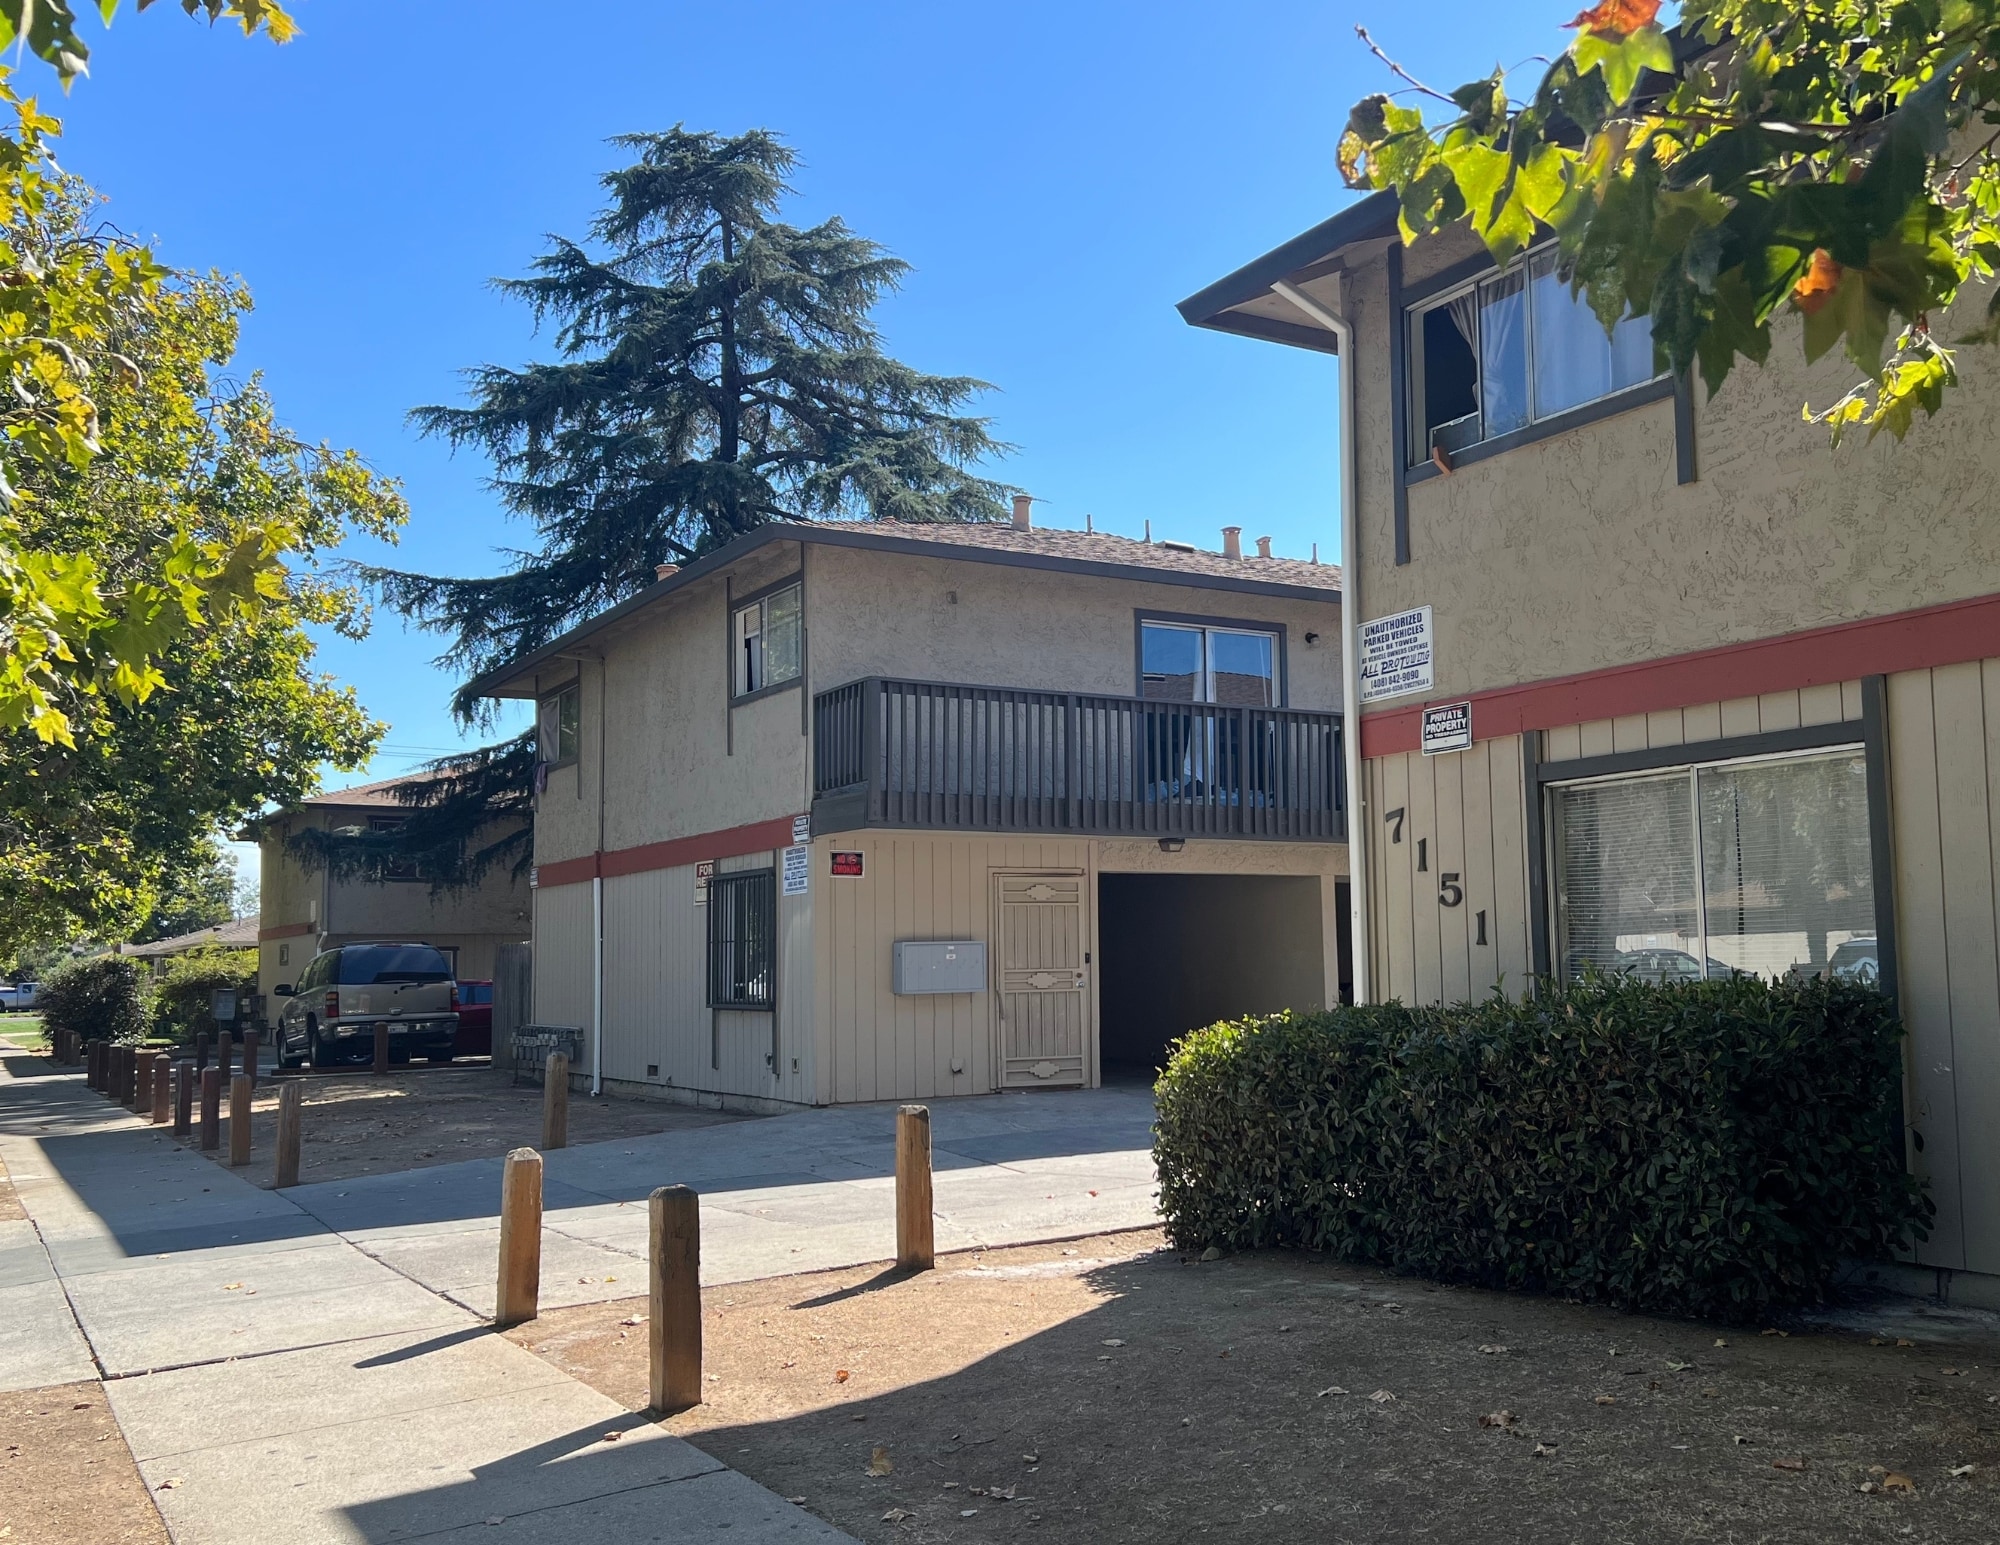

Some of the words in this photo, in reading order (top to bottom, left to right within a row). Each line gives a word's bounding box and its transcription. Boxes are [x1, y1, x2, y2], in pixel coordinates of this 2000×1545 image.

[1365, 613, 1422, 637] UNAUTHORIZED
[1364, 633, 1389, 647] PARKED
[1391, 624, 1424, 639] VEHICLES
[1370, 645, 1384, 654] WILL
[1395, 637, 1417, 647] TOWED
[1361, 663, 1378, 680] ALL
[1430, 708, 1462, 723] PRIVATE
[1426, 718, 1467, 734] PROPERTY
[699, 864, 713, 876] FOR
[833, 864, 861, 874] SMOKING
[1385, 807, 1488, 945] 7151
